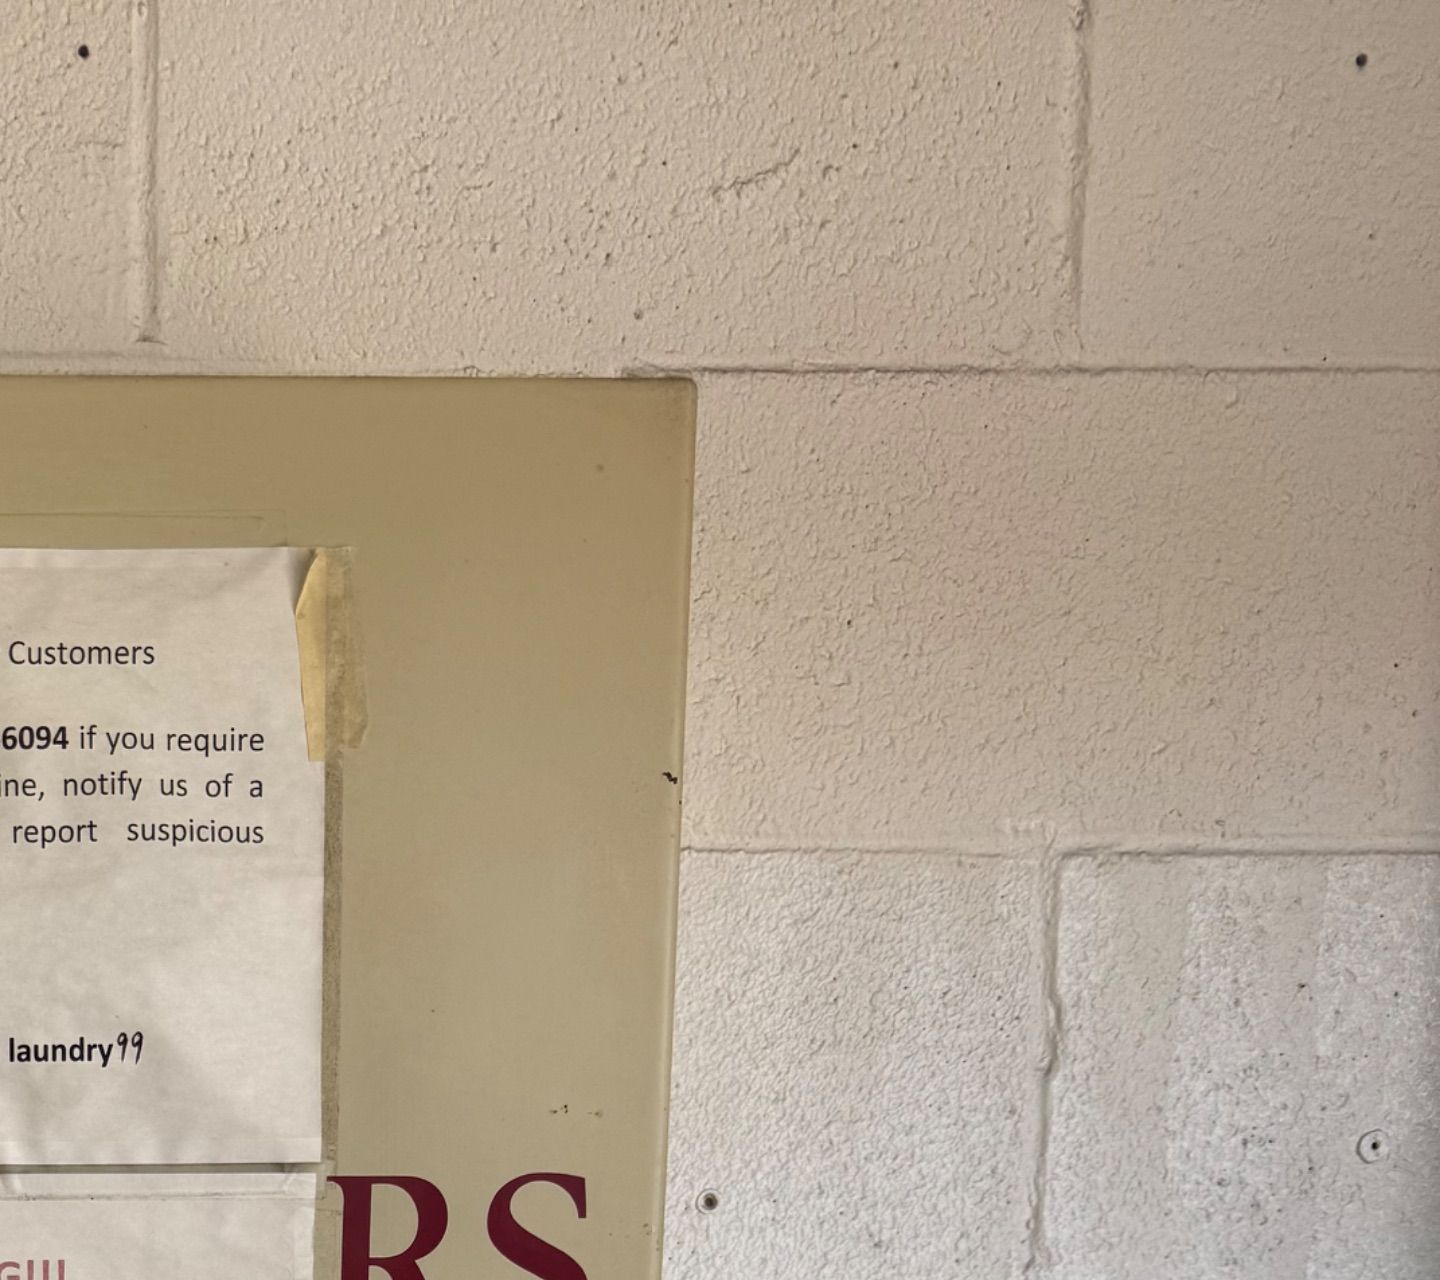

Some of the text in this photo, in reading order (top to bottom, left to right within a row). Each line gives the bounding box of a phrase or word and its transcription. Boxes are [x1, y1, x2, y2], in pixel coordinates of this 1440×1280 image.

[9, 641, 154, 665] Customers
[80, 725, 97, 749] if
[106, 732, 154, 755] you
[167, 727, 264, 757] require
[64, 770, 142, 801] notify
[161, 779, 187, 796] us
[206, 773, 233, 797] of
[250, 780, 262, 797] a
[13, 821, 97, 848] report
[128, 819, 264, 847] suspicious
